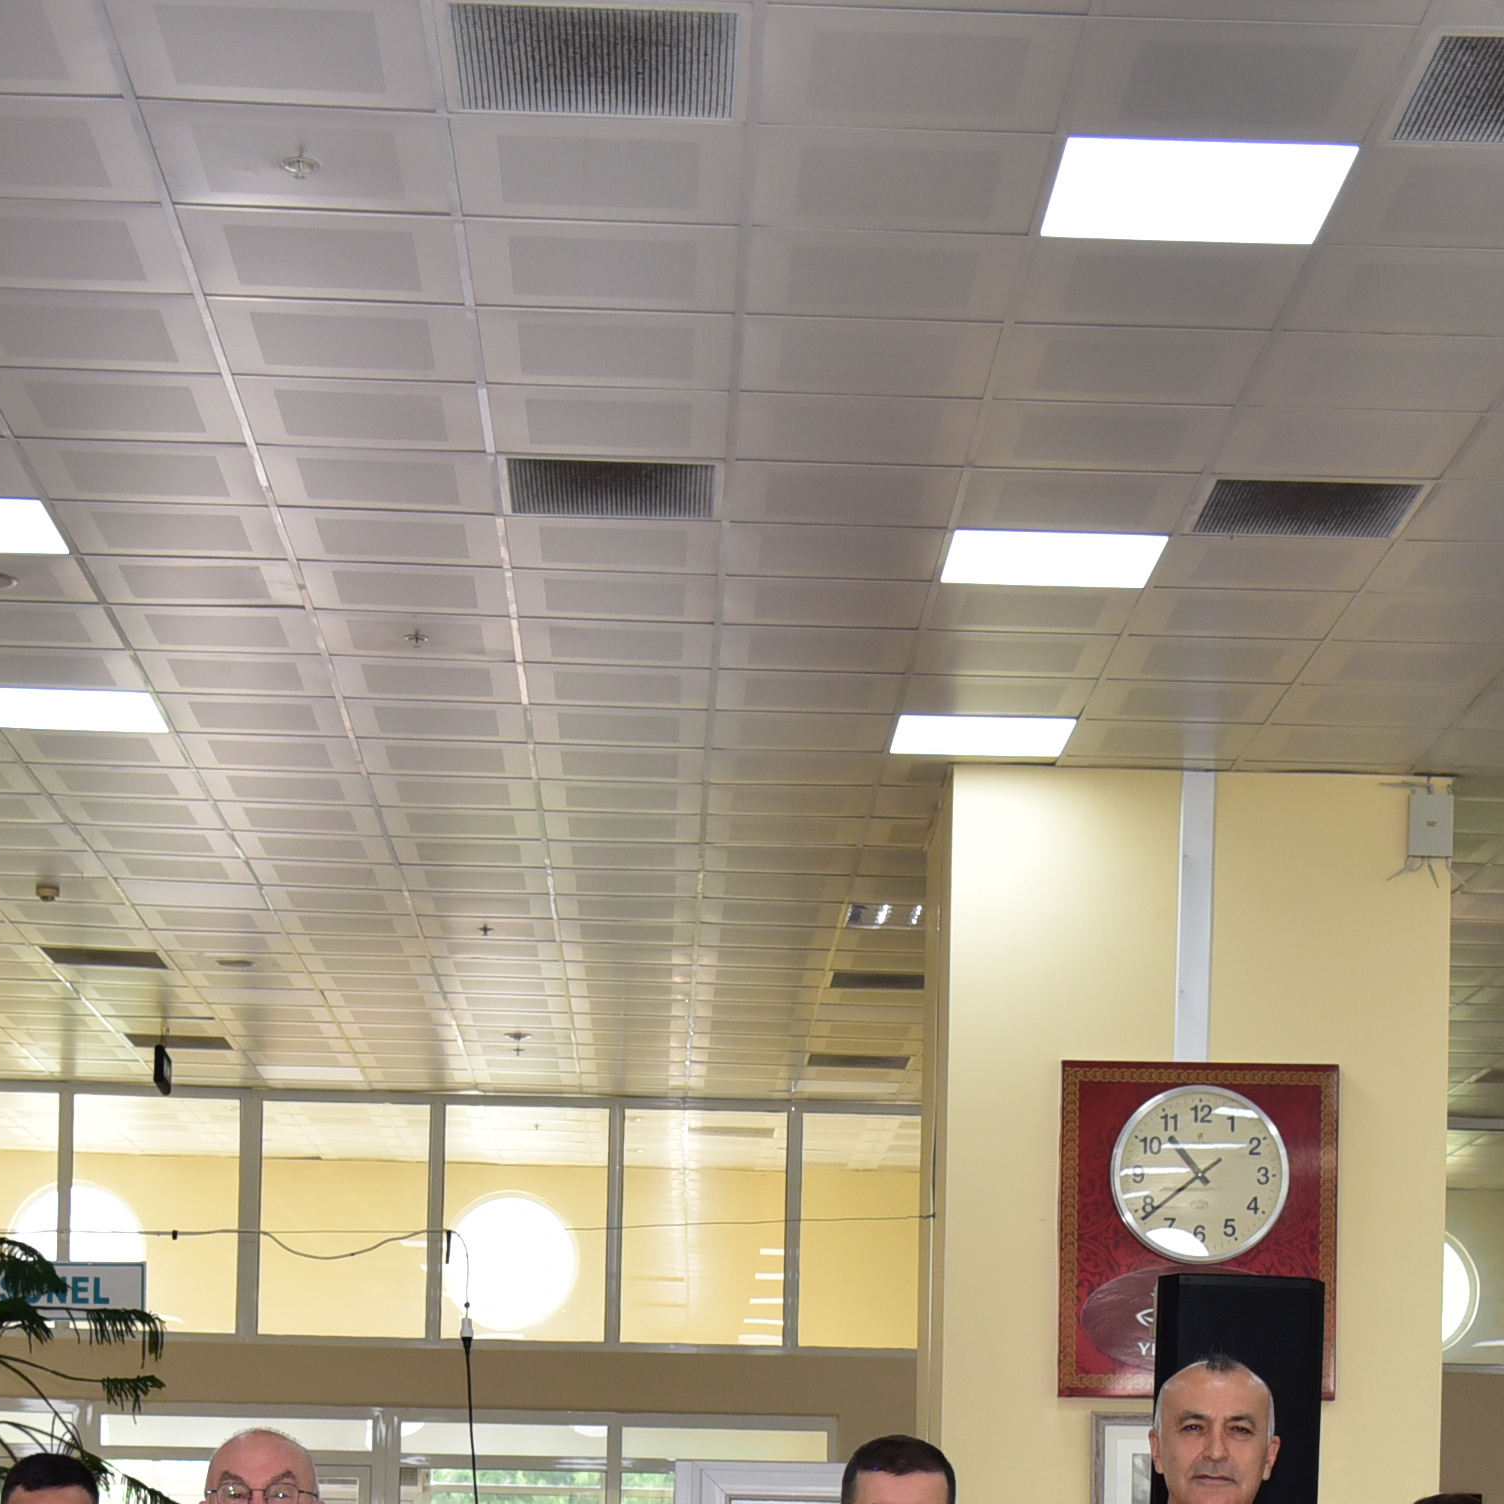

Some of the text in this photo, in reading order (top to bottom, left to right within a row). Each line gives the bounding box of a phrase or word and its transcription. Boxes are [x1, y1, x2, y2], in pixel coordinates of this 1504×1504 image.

[1160, 1113, 1178, 1132] 11
[1190, 1104, 1213, 1124] 12
[1226, 1115, 1235, 1133] 1
[1139, 1136, 1162, 1155] 10
[1248, 1137, 1261, 1156] 2
[1132, 1165, 1145, 1184] 9
[1256, 1166, 1270, 1185] 3
[1141, 1195, 1155, 1215] 8
[1246, 1196, 1260, 1215] 4
[1193, 1225, 1206, 1243] 6
[1223, 1218, 1236, 1237] 5
